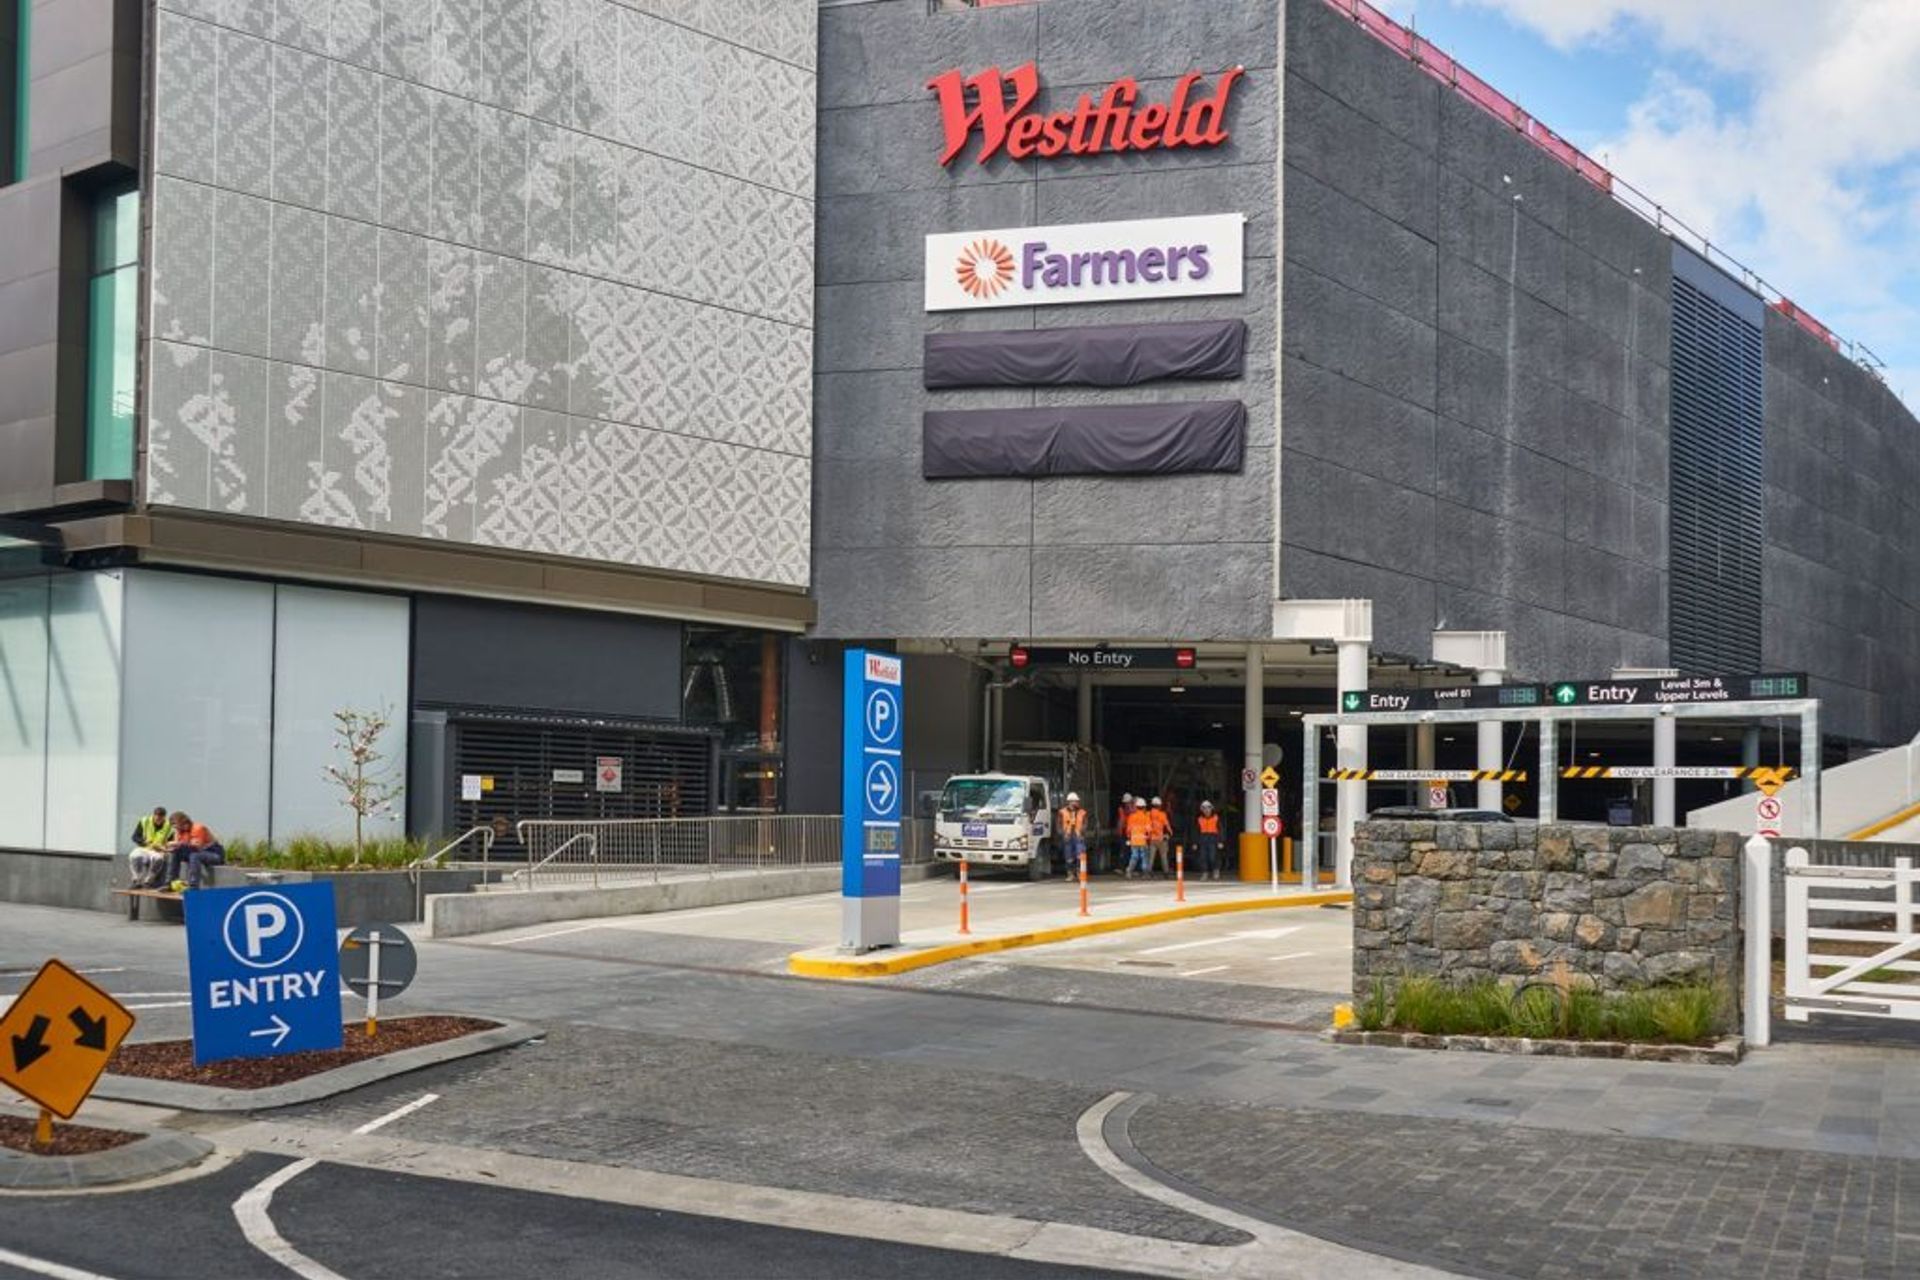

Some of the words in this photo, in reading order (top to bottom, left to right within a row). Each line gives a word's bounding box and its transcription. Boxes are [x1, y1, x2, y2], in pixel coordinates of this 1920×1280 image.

[927, 60, 1244, 167] Westfield
[1022, 241, 1210, 289] Farmers
[1068, 651, 1090, 664] No
[1094, 651, 1133, 668] Entry
[1661, 678, 1691, 690] Level
[1693, 678, 1711, 689] 3m
[1714, 678, 1723, 688] &
[1370, 694, 1410, 710] Entry
[1434, 689, 1458, 699] Level
[1588, 686, 1638, 705] Entry
[1655, 690, 1690, 702] Upper
[1693, 689, 1729, 700] Levels
[876, 700, 889, 731] P
[1617, 767, 1639, 777] LOW
[1642, 767, 1700, 777] CLEARANCE
[245, 903, 287, 957] P
[210, 970, 326, 1009] ENTRY
